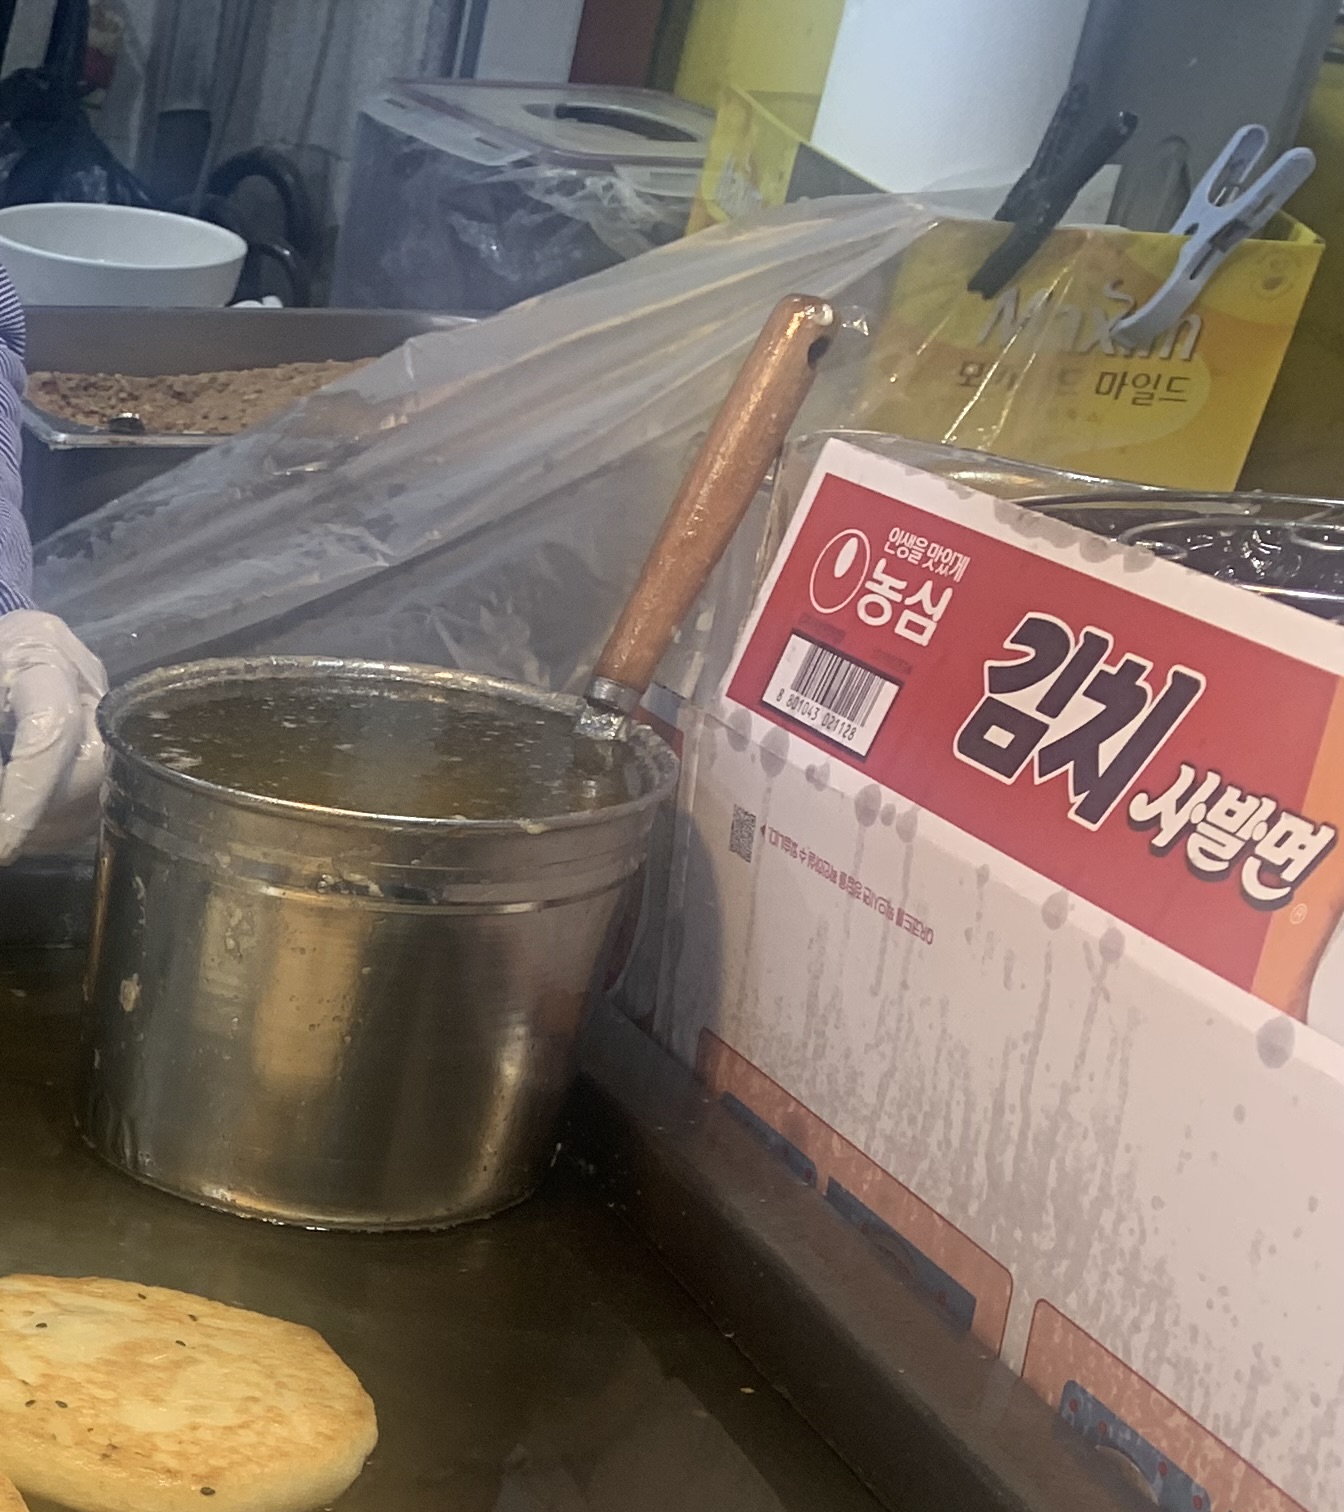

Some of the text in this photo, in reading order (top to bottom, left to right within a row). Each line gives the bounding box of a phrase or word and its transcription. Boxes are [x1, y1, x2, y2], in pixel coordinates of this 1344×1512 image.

[1094, 370, 1190, 406] 마일드
[884, 527, 971, 583] 인생을 맛있게
[857, 557, 953, 647] 농심
[776, 688, 857, 741] 8 801043 021128
[953, 612, 1336, 906] 김치 사발면
